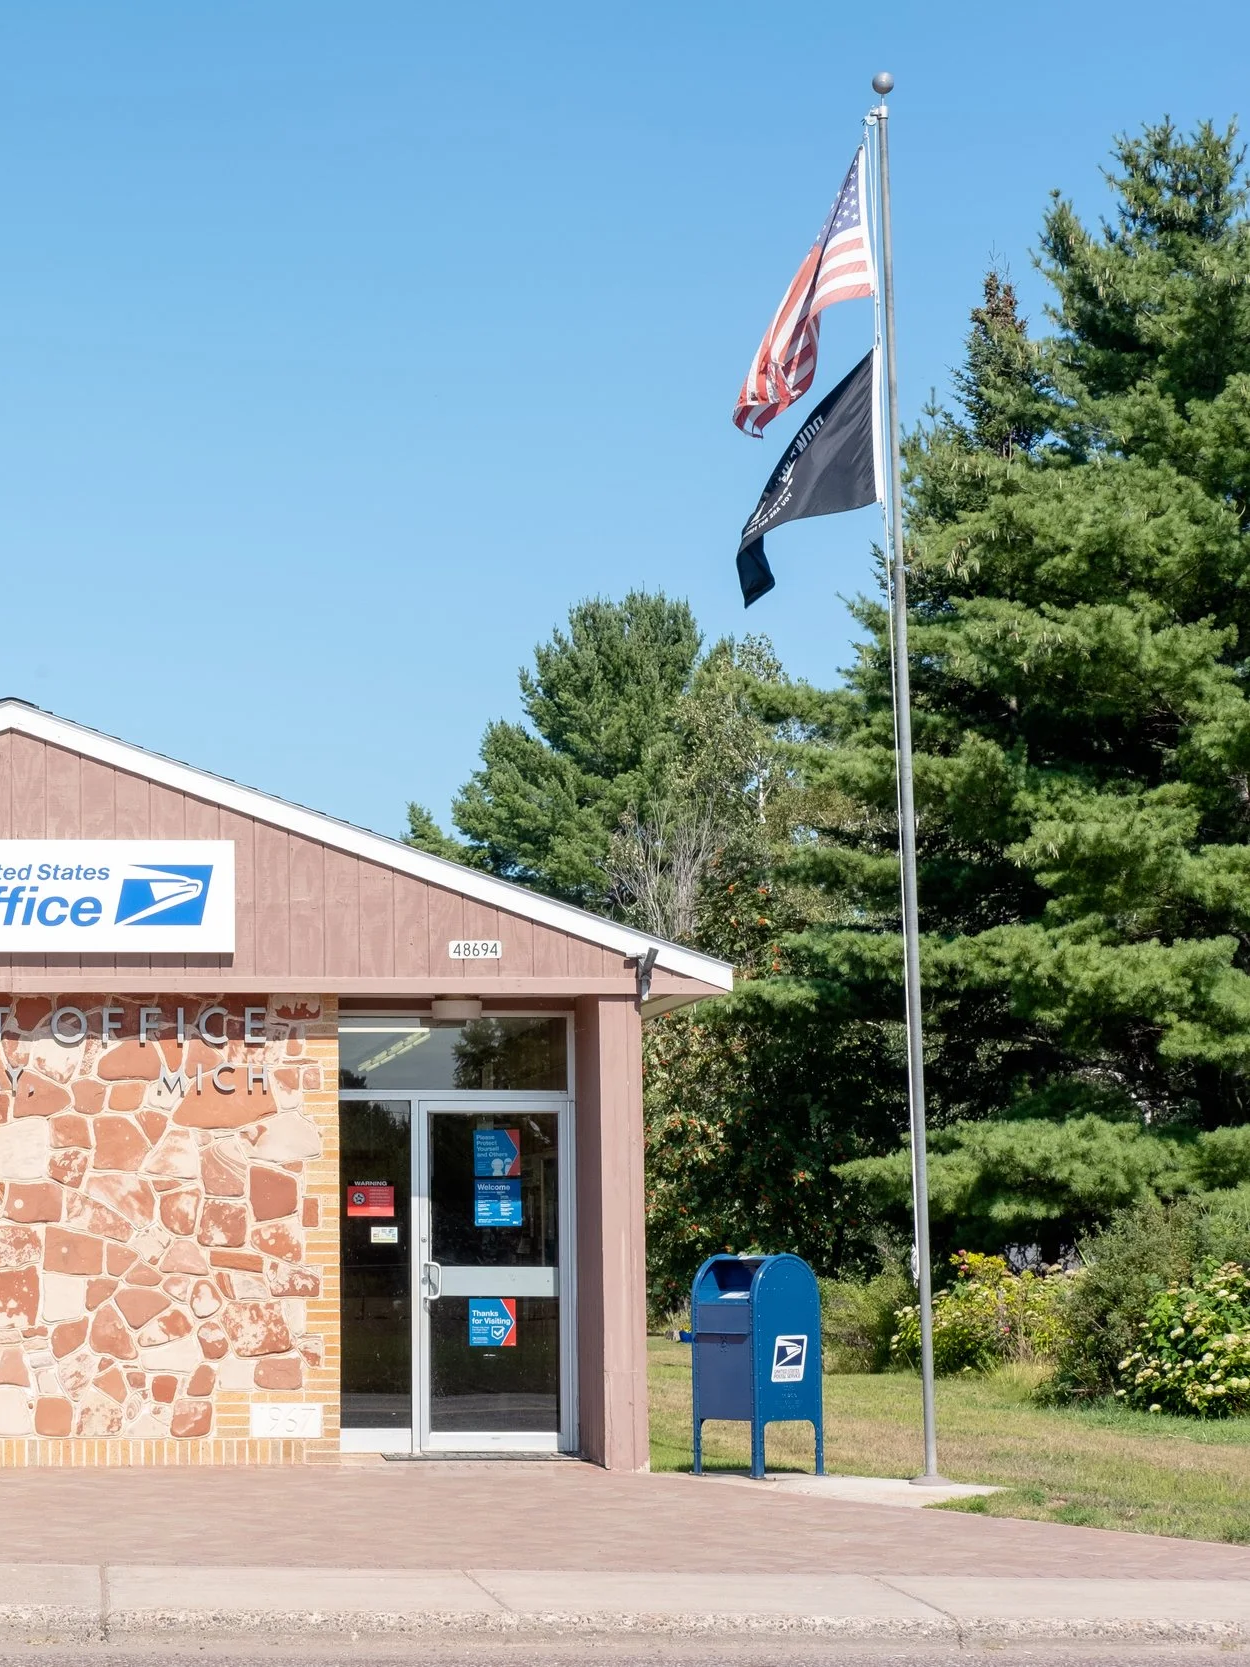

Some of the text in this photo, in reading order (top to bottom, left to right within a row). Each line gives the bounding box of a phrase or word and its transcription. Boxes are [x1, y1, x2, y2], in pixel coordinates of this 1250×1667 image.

[36, 863, 111, 881] States
[453, 942, 499, 957] 48694
[51, 1005, 268, 1045] OFFICE
[158, 1062, 270, 1096] MICH
[258, 1406, 317, 1433] 967
